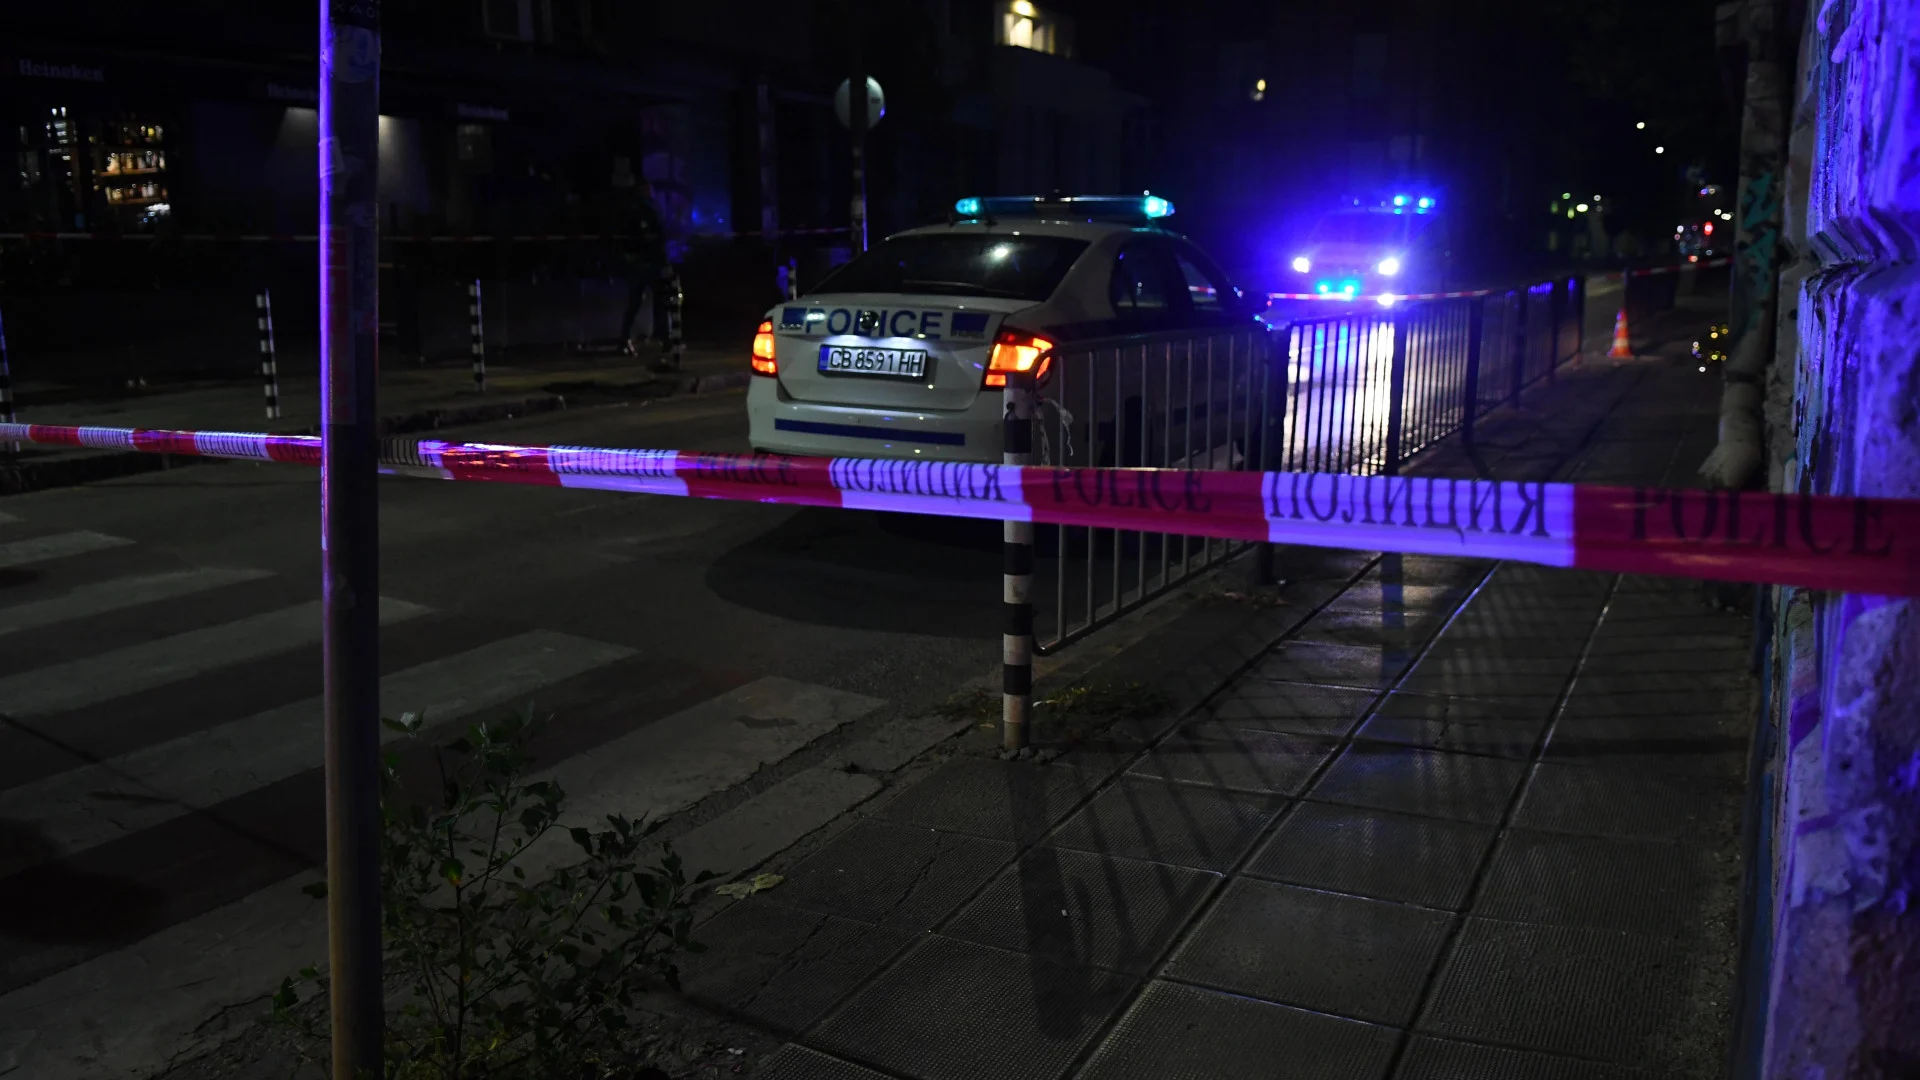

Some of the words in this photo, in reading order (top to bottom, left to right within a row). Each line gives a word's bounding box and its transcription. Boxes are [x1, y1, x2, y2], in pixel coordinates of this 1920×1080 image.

[19, 58, 105, 82] Heineken
[805, 308, 943, 339] POLICE
[830, 350, 852, 369] CB
[855, 351, 894, 371] 8591
[898, 353, 923, 374] HH
[831, 457, 1007, 503] ПОЛИЦИЯ
[1052, 469, 1213, 513] POLICE
[1269, 472, 1551, 545] ПОЛИЦИЯ
[1632, 489, 1896, 558] POLICE
